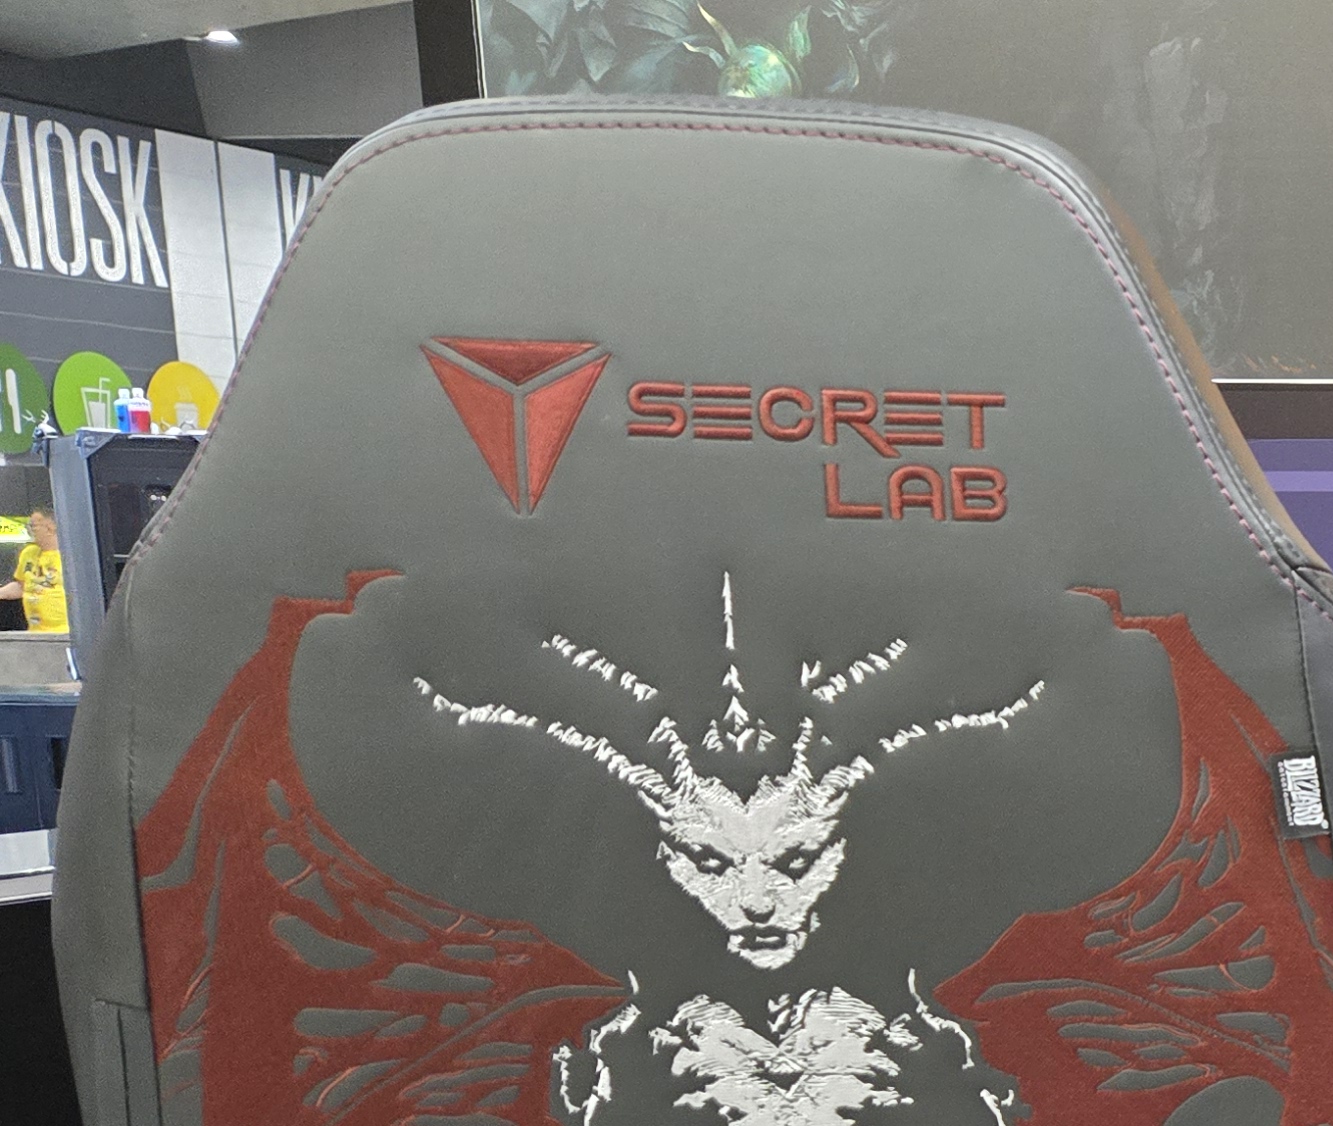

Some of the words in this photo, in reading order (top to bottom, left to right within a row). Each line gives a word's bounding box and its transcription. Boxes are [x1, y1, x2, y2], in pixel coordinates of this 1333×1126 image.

[627, 381, 1006, 458] SECRET
[824, 463, 1007, 522] LAB
[1283, 755, 1325, 826] BLIZZARD
